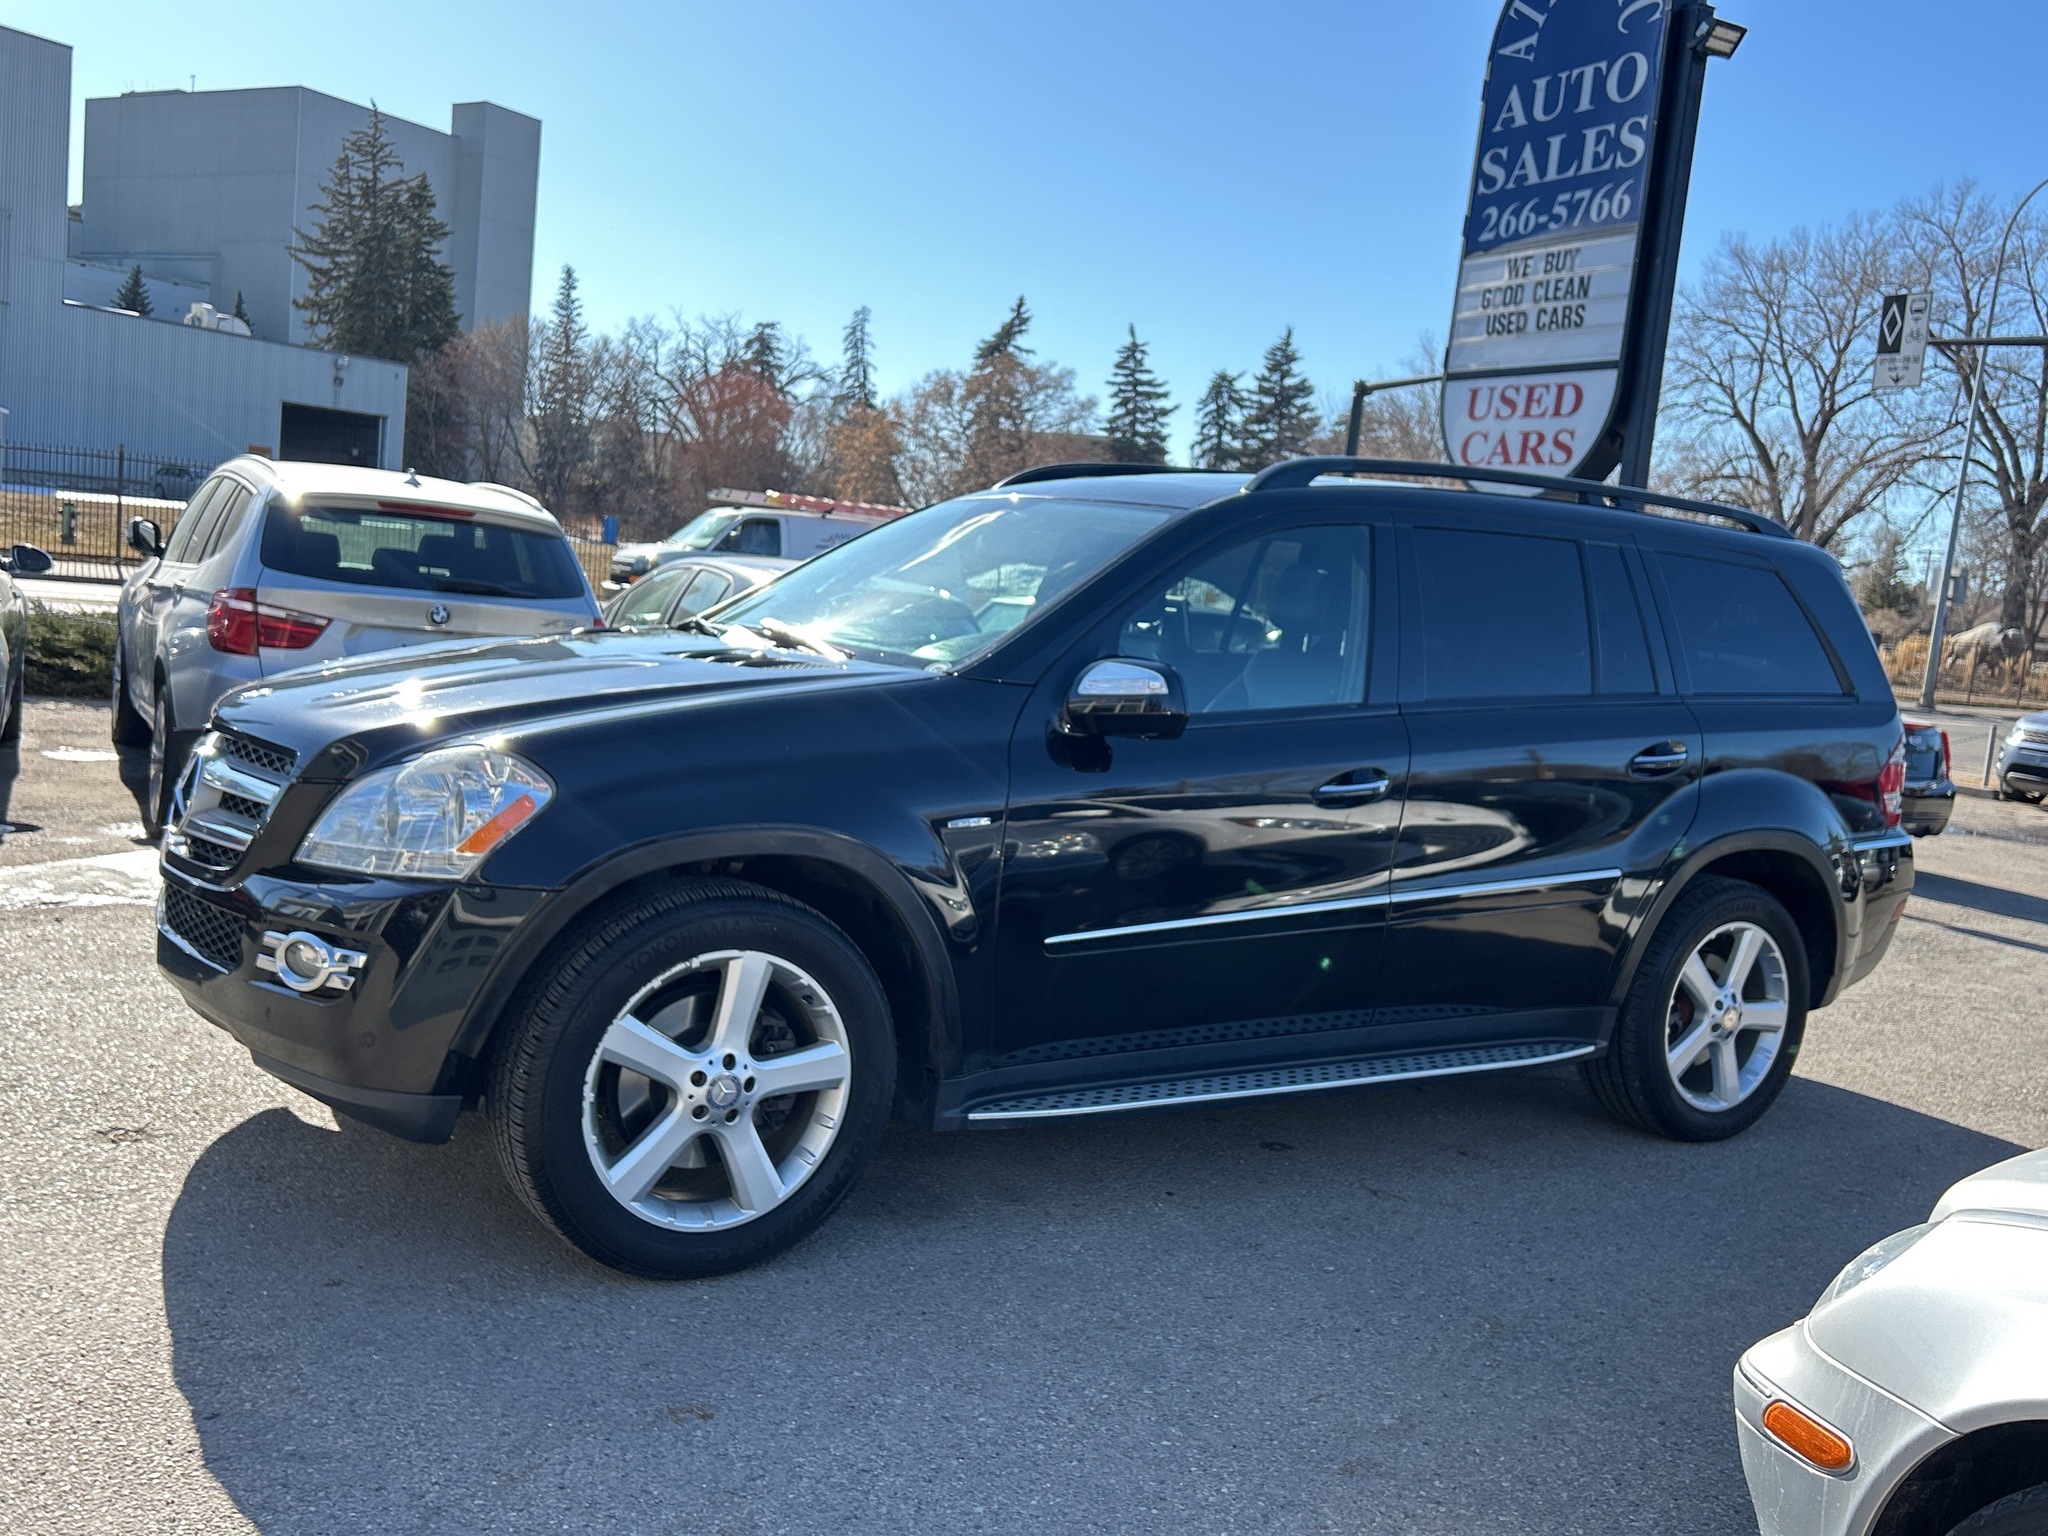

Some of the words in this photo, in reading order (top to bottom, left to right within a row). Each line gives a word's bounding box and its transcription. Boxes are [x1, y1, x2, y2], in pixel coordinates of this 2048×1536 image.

[1492, 51, 1650, 132] AUTO
[1477, 114, 1650, 195] SALES
[1478, 178, 1635, 242] 266-5766
[1508, 255, 1534, 279] WE
[1544, 247, 1581, 274] BUY
[1532, 273, 1591, 304] CLEAN
[1486, 311, 1528, 336] USED
[1536, 304, 1586, 331] CARS
[1466, 381, 1584, 422] USED
[1461, 428, 1576, 467] CARS
